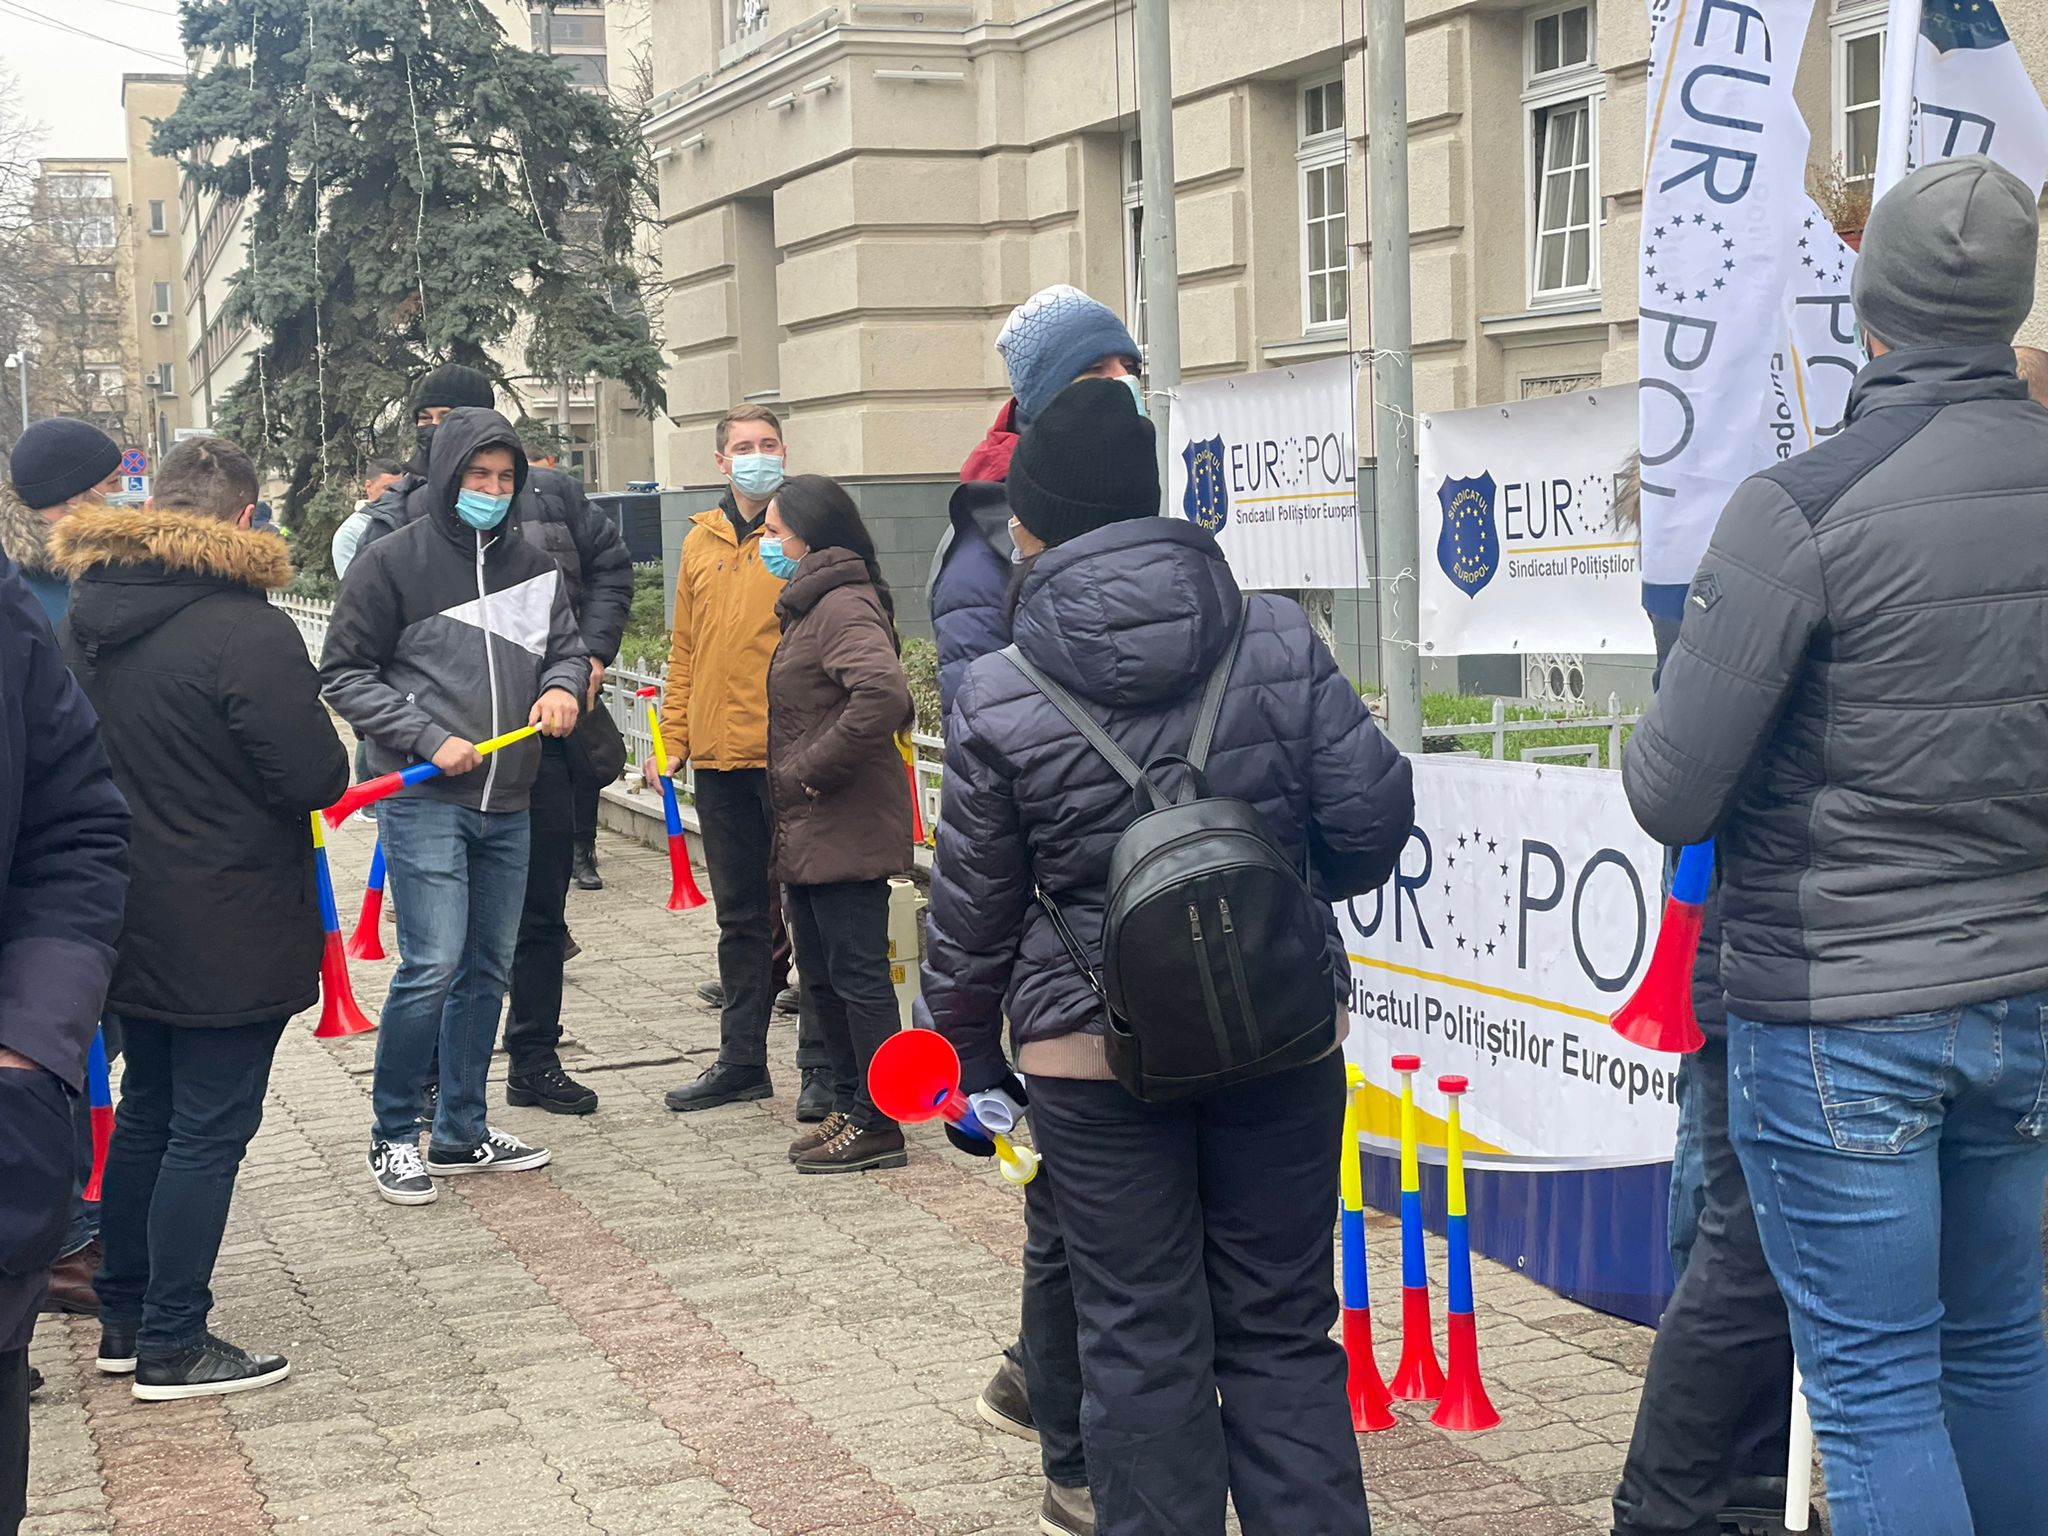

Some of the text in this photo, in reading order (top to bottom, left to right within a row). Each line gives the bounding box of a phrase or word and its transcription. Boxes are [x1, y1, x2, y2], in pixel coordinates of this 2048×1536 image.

[1231, 432, 1356, 492] EUROPOL
[1236, 506, 1275, 524] Sndcatul
[1448, 488, 1488, 520] SINDICATUL
[1453, 562, 1489, 583] EUROPOL
[1509, 554, 1635, 580] Sindicatul Polițiștilor
[1426, 997, 1554, 1068] Polițiștilor
